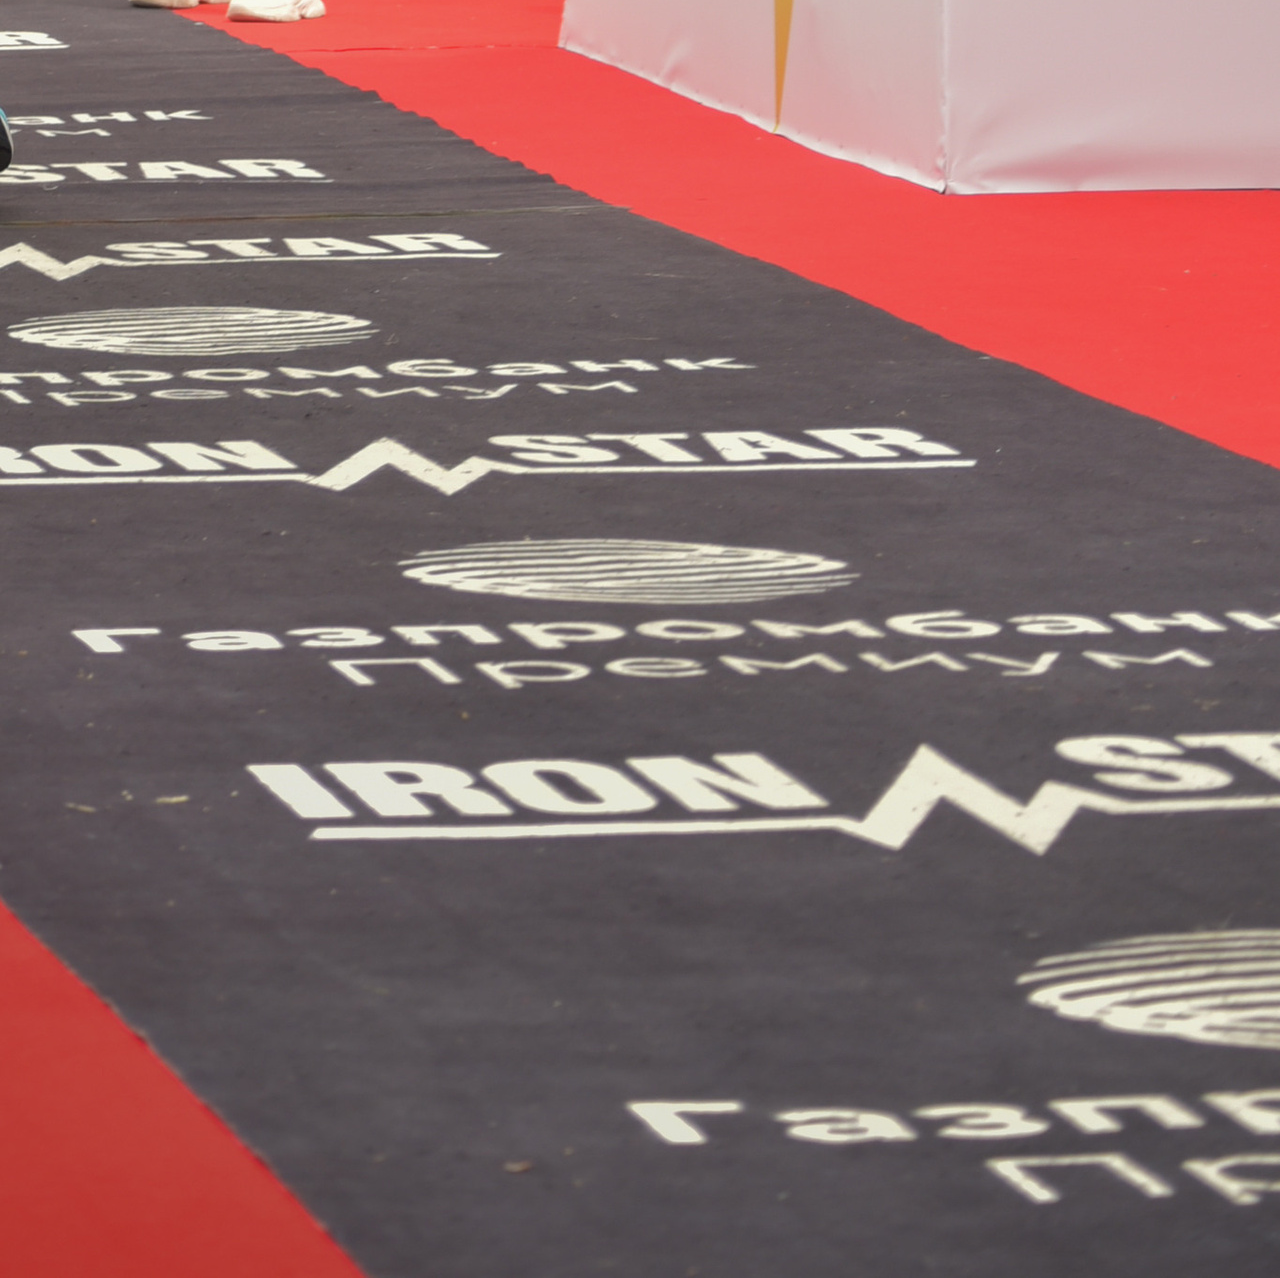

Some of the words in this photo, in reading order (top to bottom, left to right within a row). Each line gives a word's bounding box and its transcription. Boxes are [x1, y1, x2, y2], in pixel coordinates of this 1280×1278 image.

[103, 233, 488, 259] STAR
[487, 427, 961, 464] STAR
[330, 647, 1214, 690] Премиум
[245, 751, 832, 821] IRON
